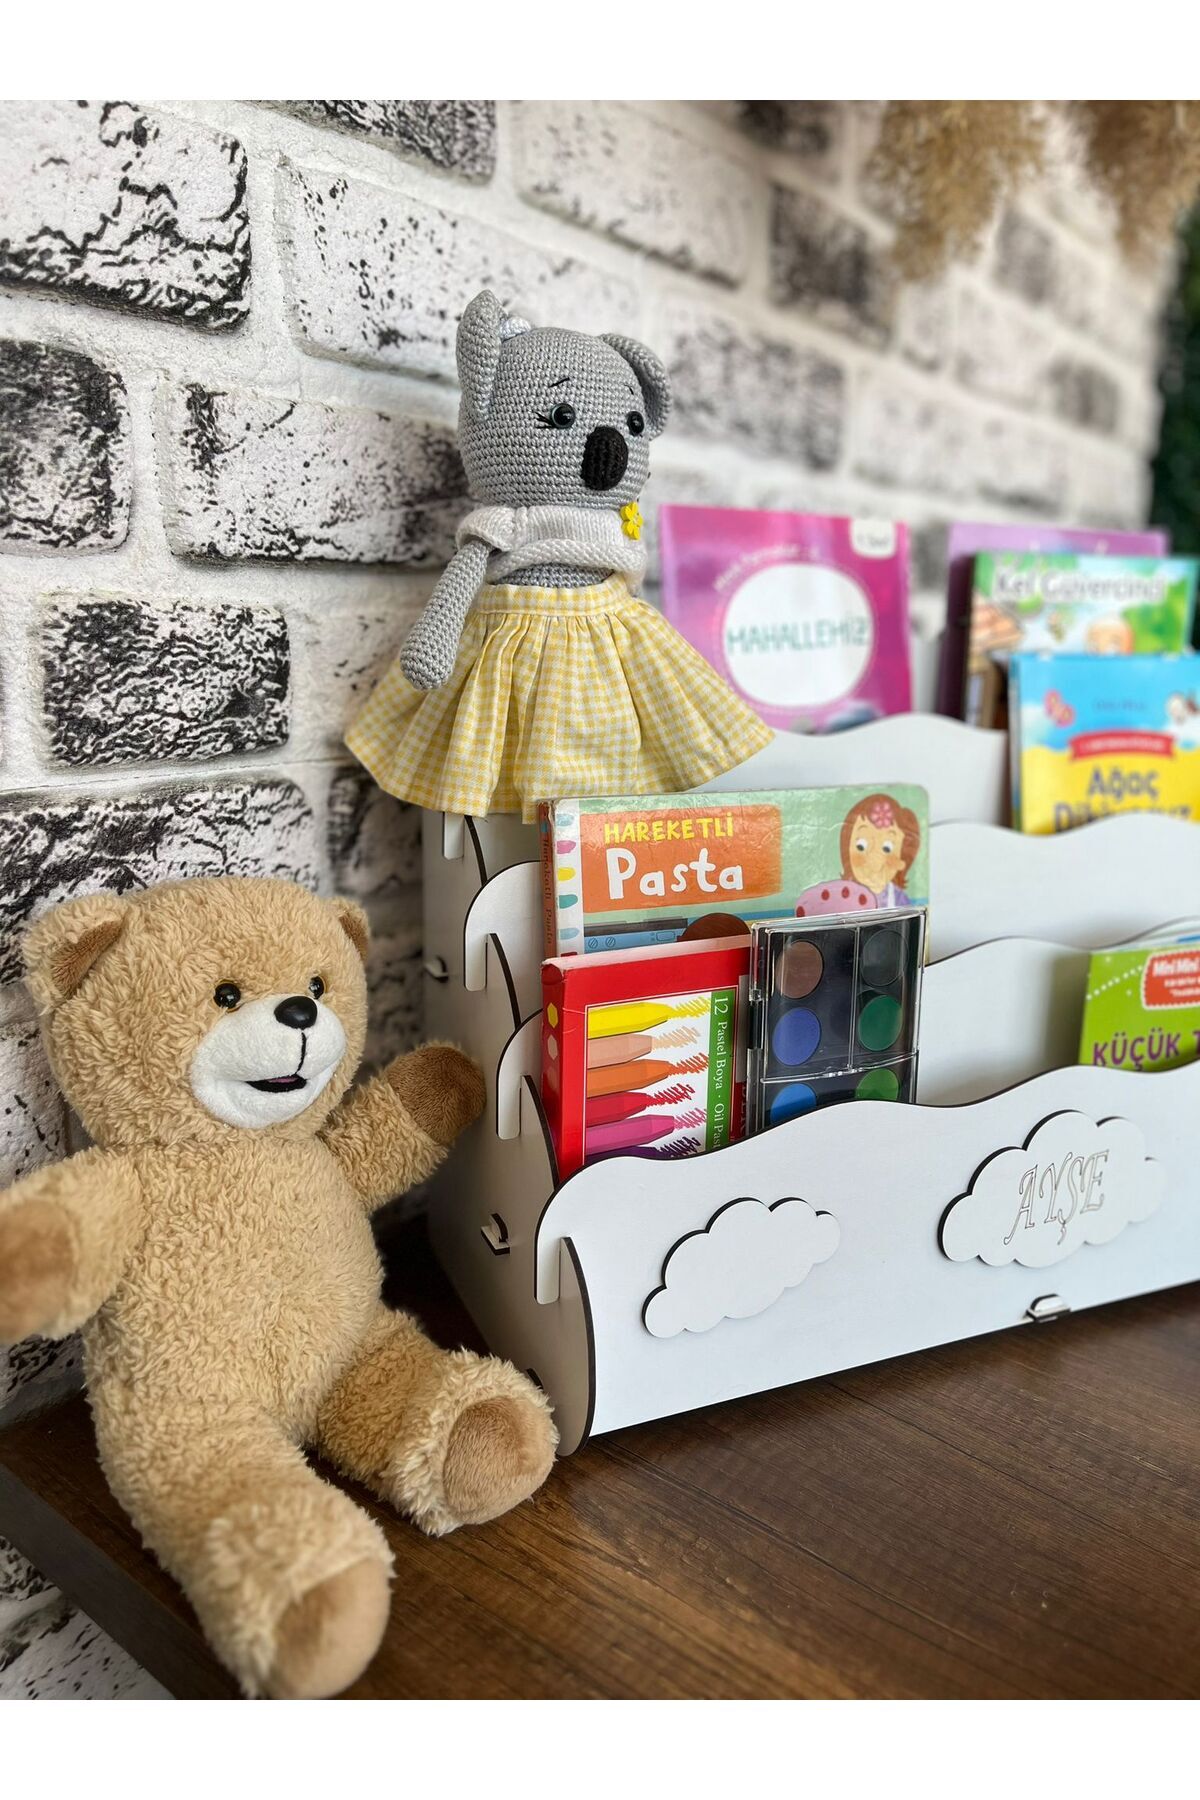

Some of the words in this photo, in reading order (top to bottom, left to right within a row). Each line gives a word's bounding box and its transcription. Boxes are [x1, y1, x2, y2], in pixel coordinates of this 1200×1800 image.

[1087, 766, 1159, 802] Ağaç
[604, 812, 734, 844] HAREKETLİ
[606, 848, 744, 900] Pasta
[714, 997, 729, 1015] 12
[716, 1021, 728, 1060] Pastel
[1092, 1027, 1181, 1071] KÜÇÜK
[714, 1060, 727, 1090] Boya
[713, 1103, 725, 1124] Oil
[1003, 1150, 1110, 1245] AYŞE
